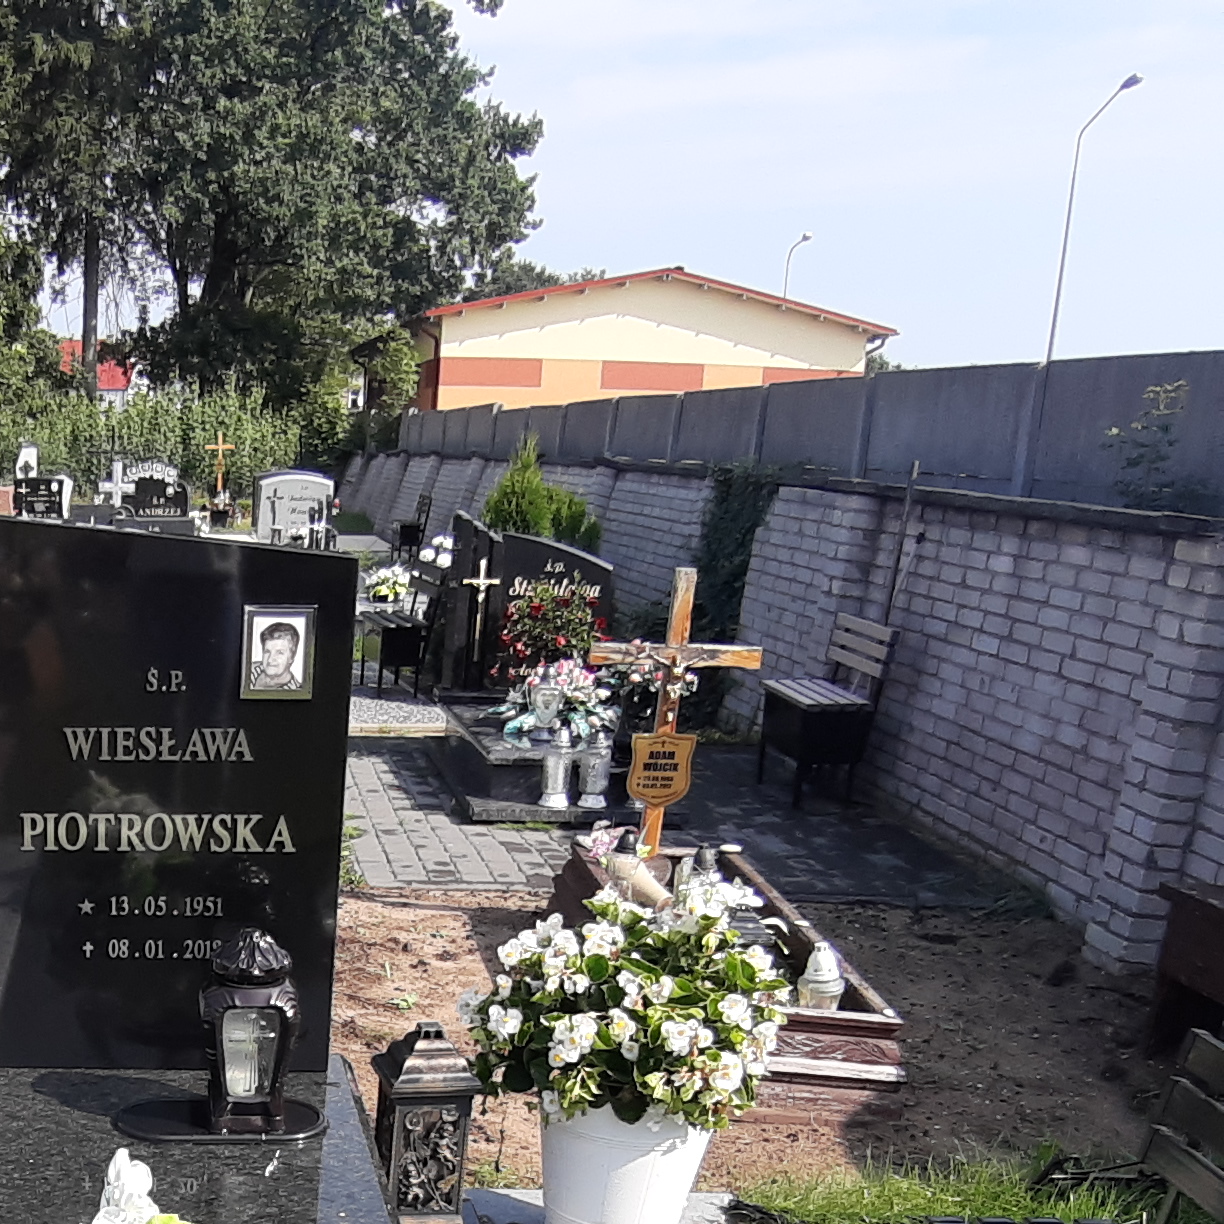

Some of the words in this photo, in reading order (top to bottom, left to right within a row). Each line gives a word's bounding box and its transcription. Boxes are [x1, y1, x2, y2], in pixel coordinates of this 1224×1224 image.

[137, 507, 182, 516] ANDRZEJ
[145, 665, 188, 692] Ś.P.
[62, 725, 255, 763] WIESŁAWA
[647, 750, 677, 760] ADAM
[642, 760, 680, 773] WÓJCIK
[19, 811, 297, 853] PIOTROWSKA
